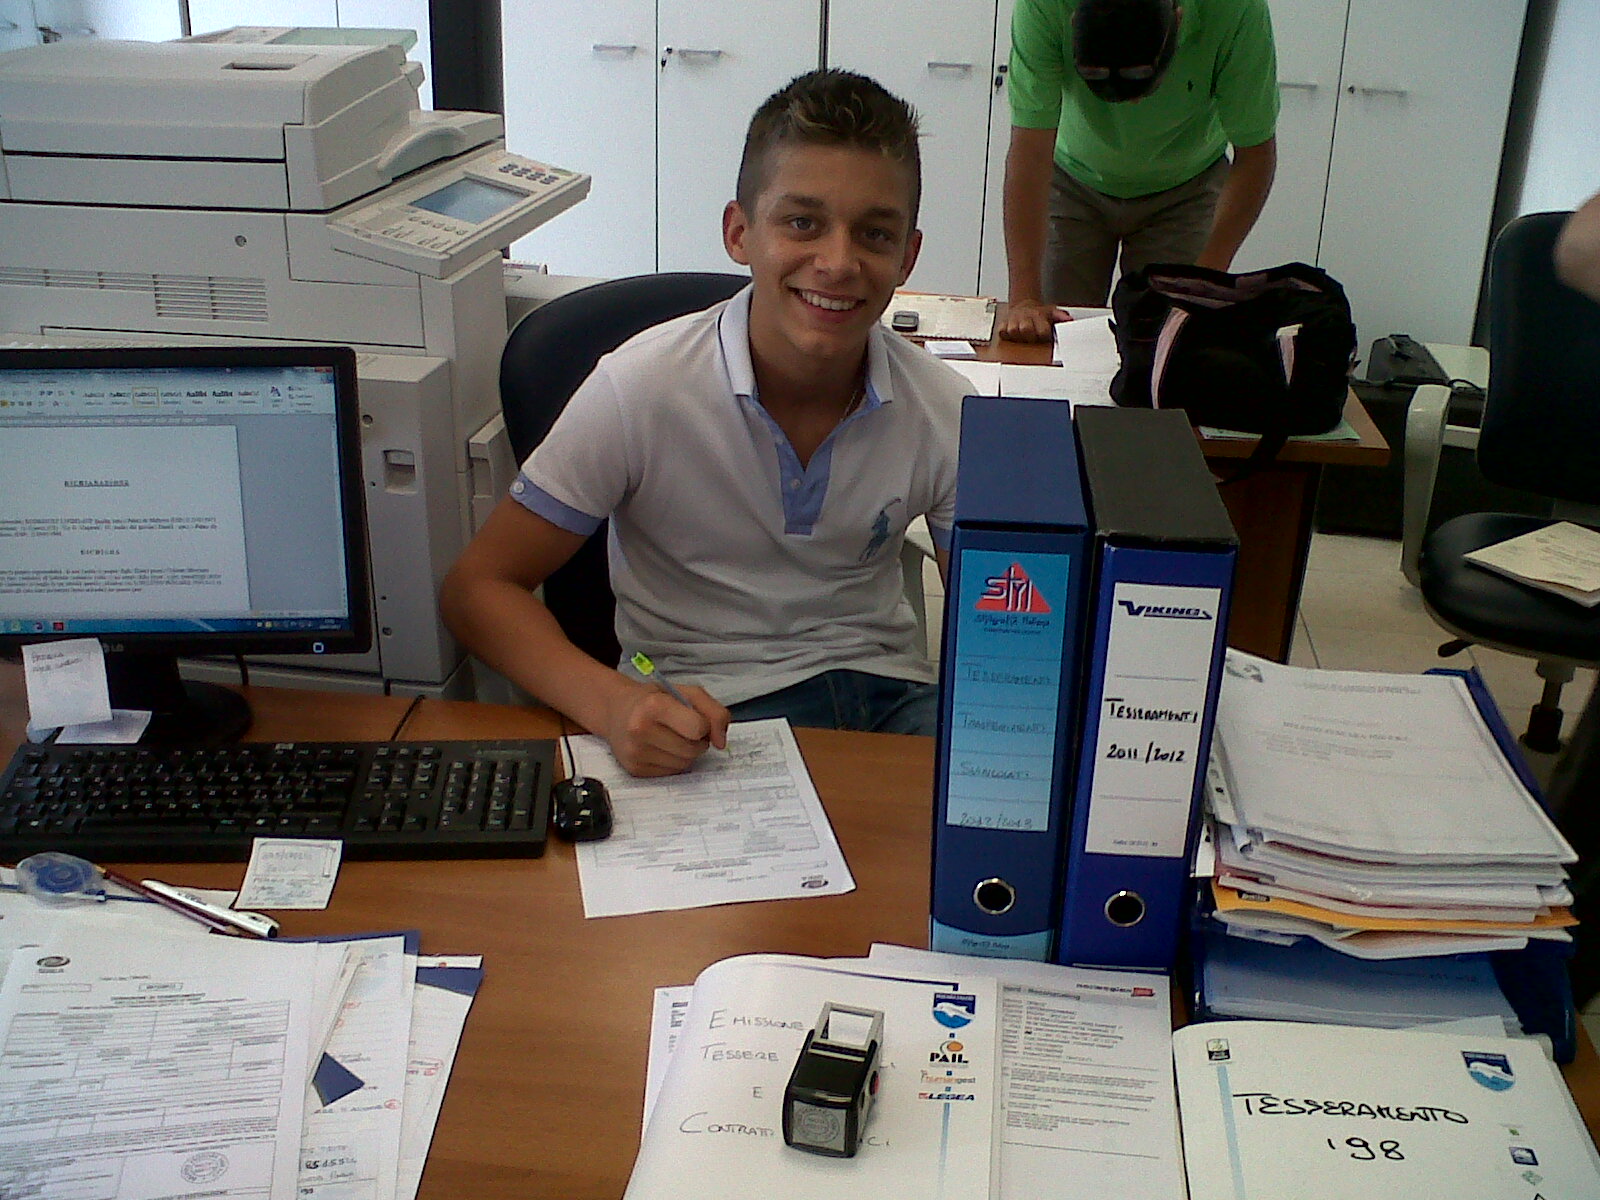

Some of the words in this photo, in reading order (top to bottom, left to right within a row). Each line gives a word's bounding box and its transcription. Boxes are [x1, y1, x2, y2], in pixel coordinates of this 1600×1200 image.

[1117, 600, 1212, 620] VIKING
[929, 1052, 969, 1064] PAIL
[1232, 1092, 1469, 1125] TESSERAMENTO
